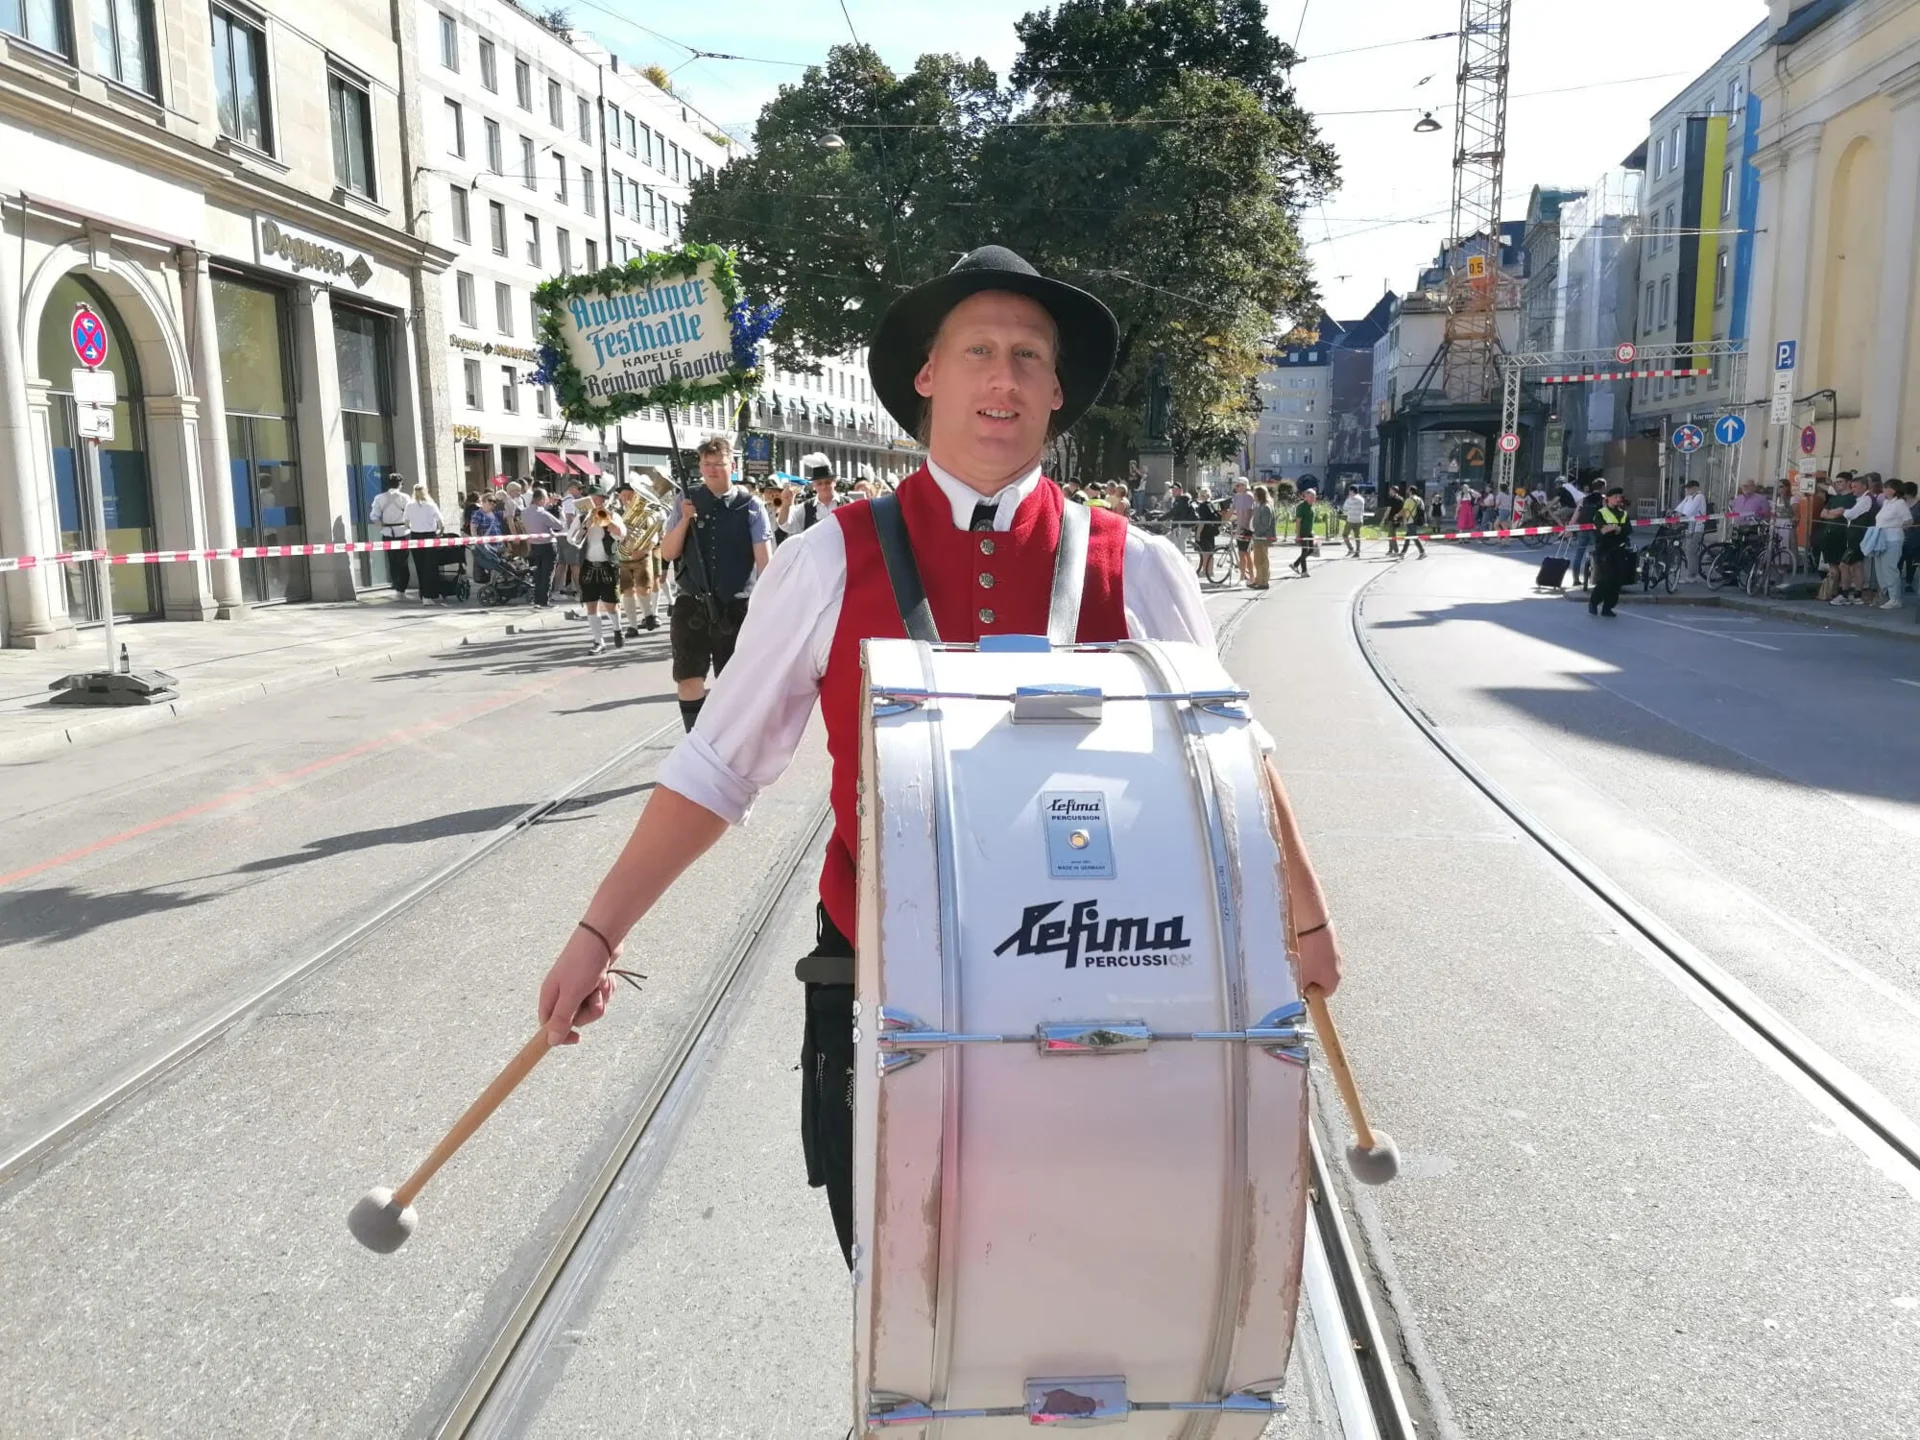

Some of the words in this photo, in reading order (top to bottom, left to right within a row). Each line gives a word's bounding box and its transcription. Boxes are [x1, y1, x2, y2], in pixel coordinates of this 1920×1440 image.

[261, 219, 345, 276] Degussa
[586, 311, 704, 370] Festhalle
[622, 347, 683, 368] KAPELLE
[1778, 344, 1790, 367] P
[584, 362, 666, 399] Reinhard
